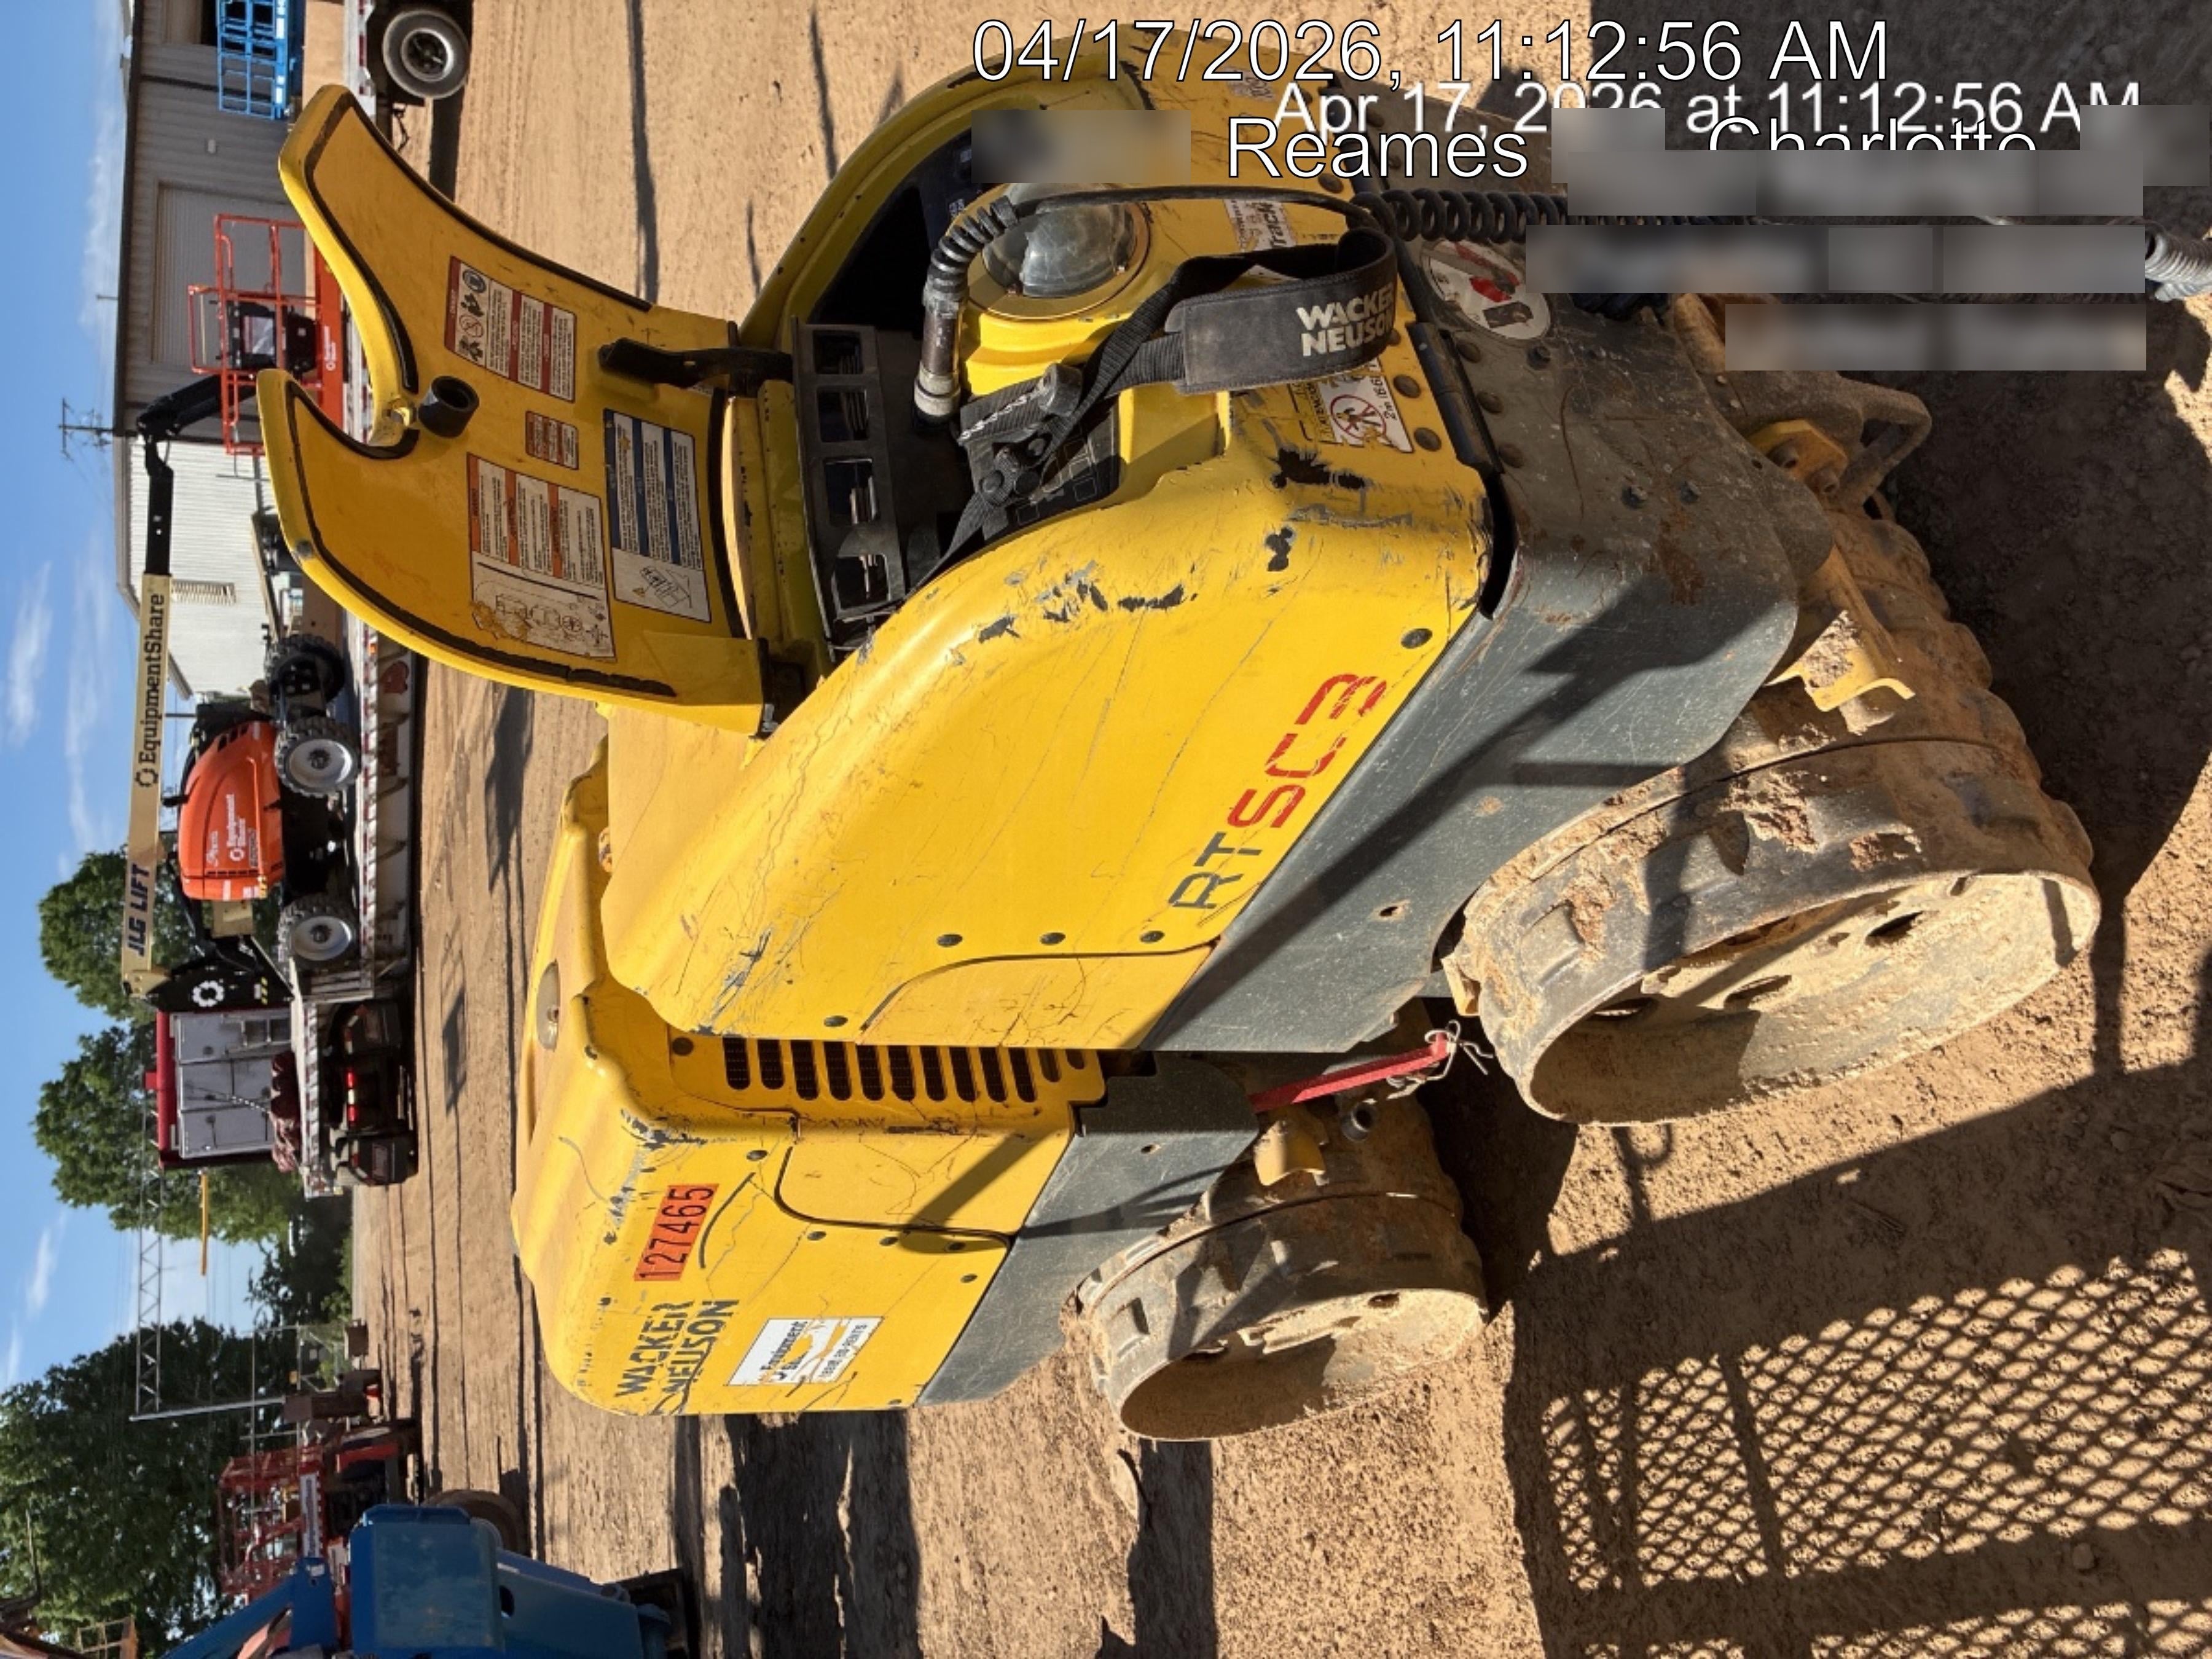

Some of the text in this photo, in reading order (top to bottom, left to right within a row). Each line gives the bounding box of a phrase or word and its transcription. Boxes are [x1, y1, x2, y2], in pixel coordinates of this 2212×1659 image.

[138, 594, 165, 764] EquipmentShare
[127, 862, 150, 957] JLG LIFT
[638, 1187, 715, 1279] 127465
[614, 1300, 696, 1398] WACKER
[661, 1299, 740, 1394] NEUSON
